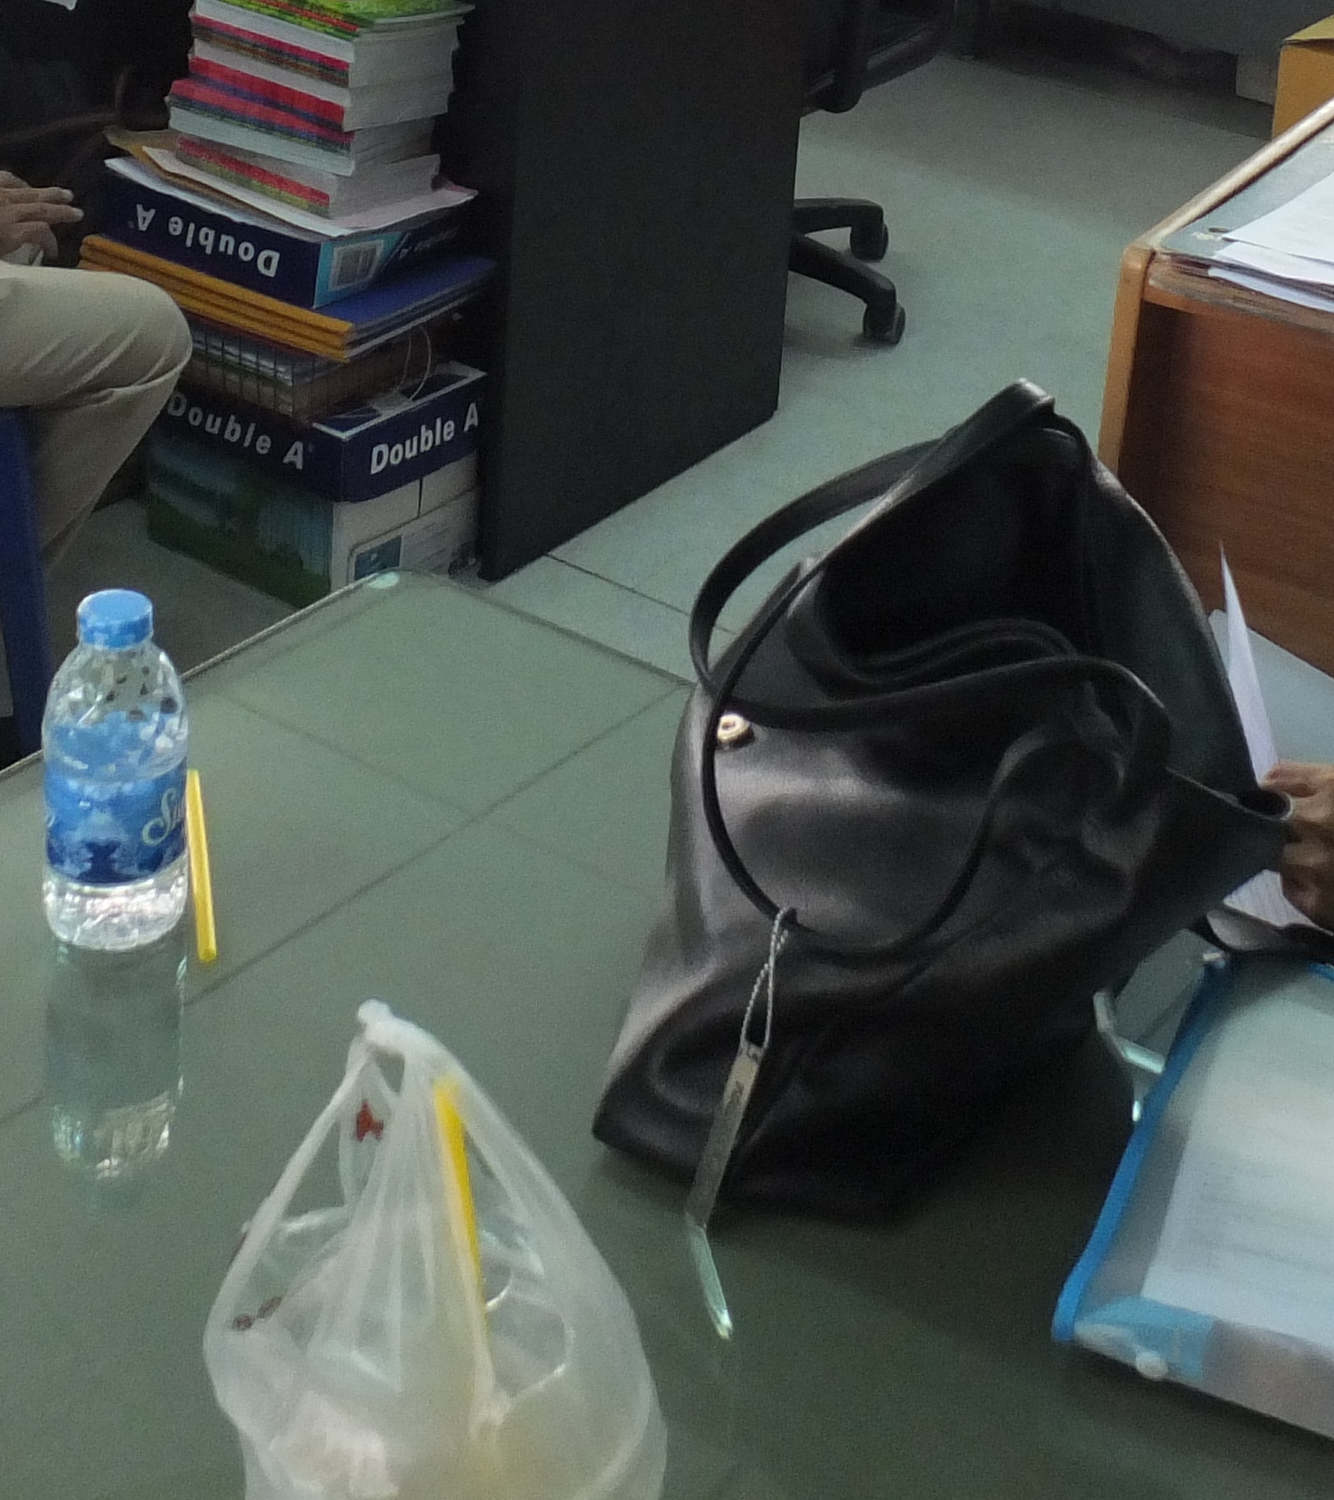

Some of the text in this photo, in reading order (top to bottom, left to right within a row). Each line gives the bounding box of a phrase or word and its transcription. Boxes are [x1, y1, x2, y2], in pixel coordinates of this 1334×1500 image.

[136, 204, 280, 278] Double A
[167, 391, 304, 470] Double A
[370, 402, 479, 475] Double A
